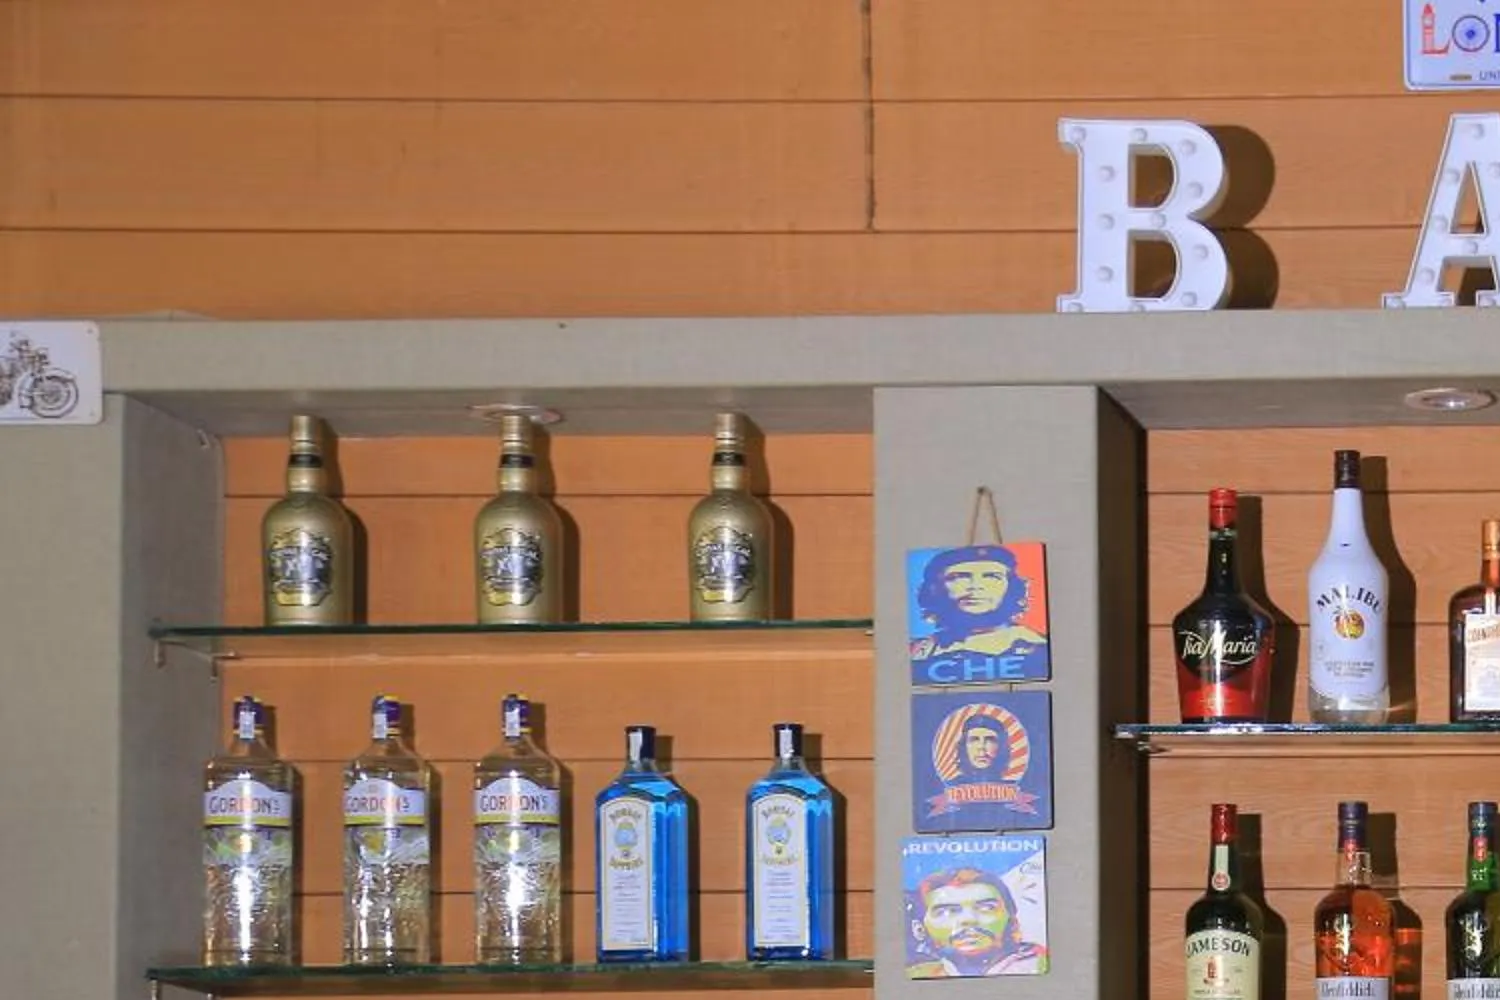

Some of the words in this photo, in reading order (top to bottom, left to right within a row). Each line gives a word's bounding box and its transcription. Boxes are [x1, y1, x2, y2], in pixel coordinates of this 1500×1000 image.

[1316, 585, 1385, 613] MALIBU
[1182, 632, 1203, 660] Tia
[1203, 627, 1257, 660] Maria
[928, 655, 1025, 683] CHE
[907, 839, 1039, 855] REVOLUTION
[1186, 937, 1250, 959] JAMESON
